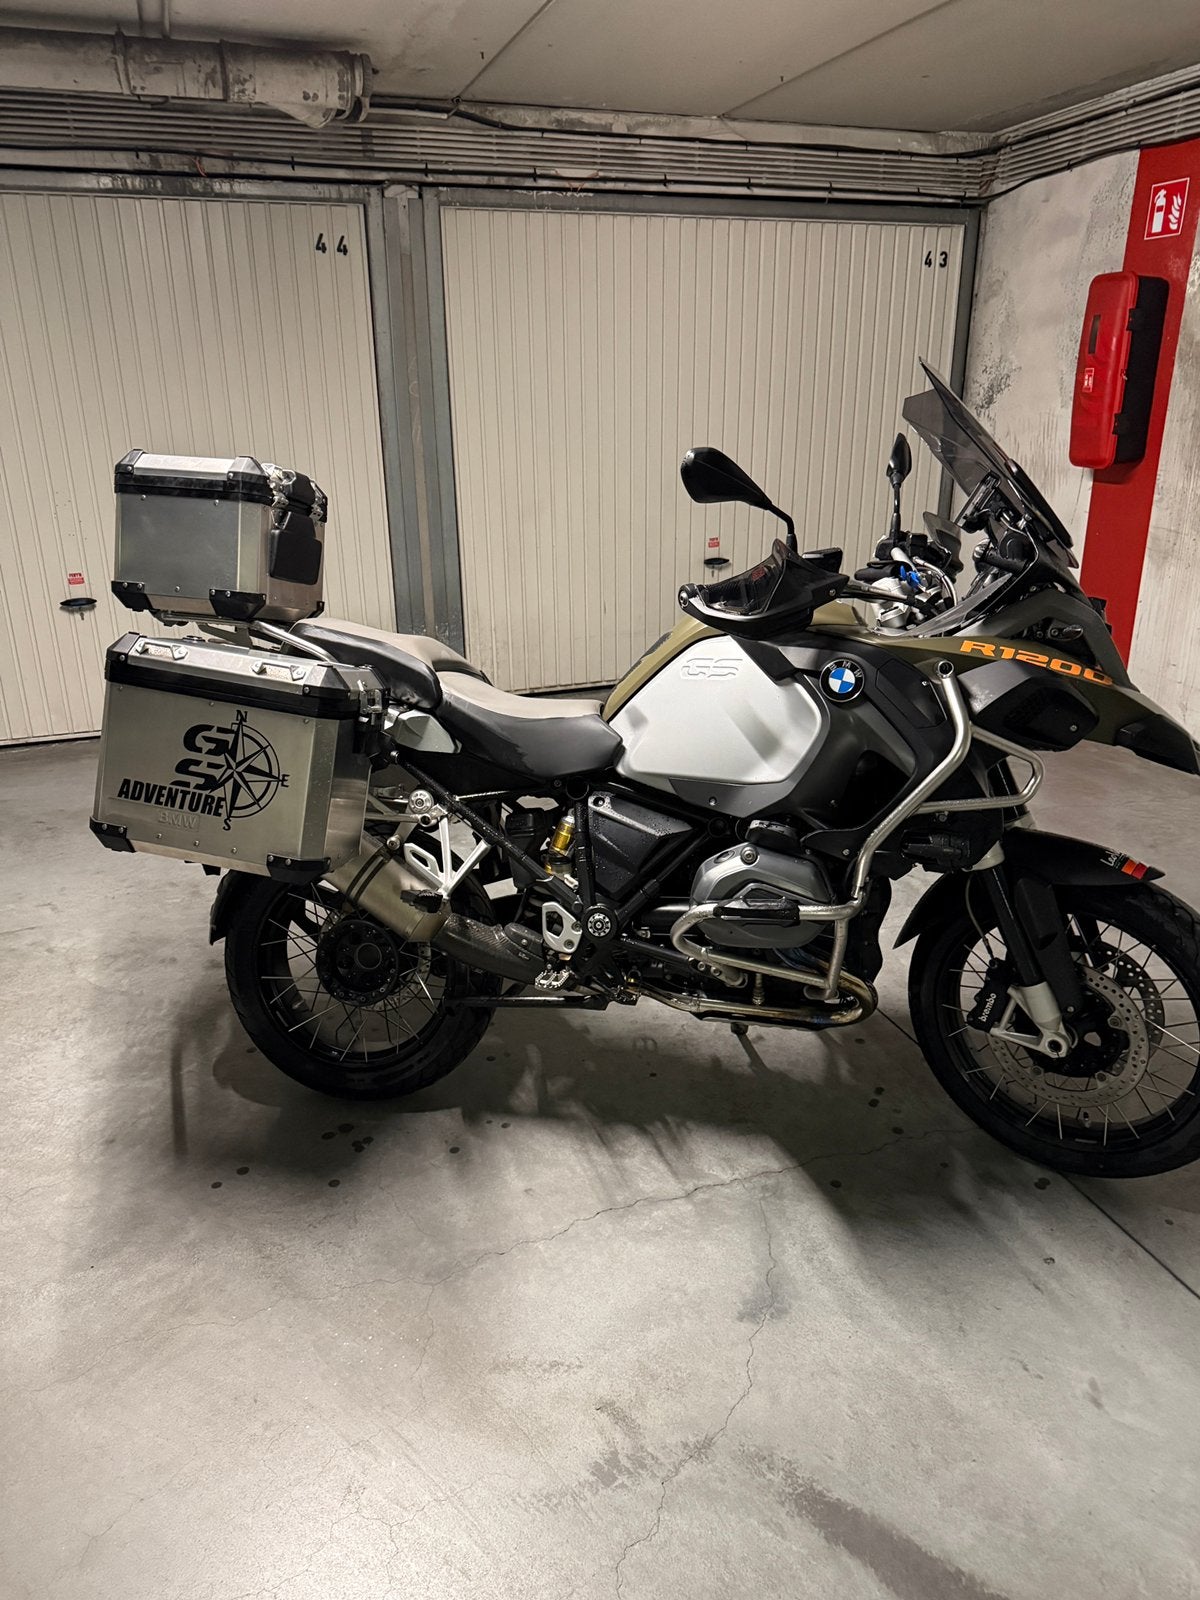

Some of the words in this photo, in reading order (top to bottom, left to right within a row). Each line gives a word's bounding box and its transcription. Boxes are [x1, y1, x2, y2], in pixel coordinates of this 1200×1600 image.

[315, 233, 348, 256] 44
[925, 250, 948, 268] 43
[681, 657, 743, 680] GS
[117, 778, 227, 818] ADVENTURE
[157, 812, 199, 830] BMW
[978, 993, 997, 1022] brembo
